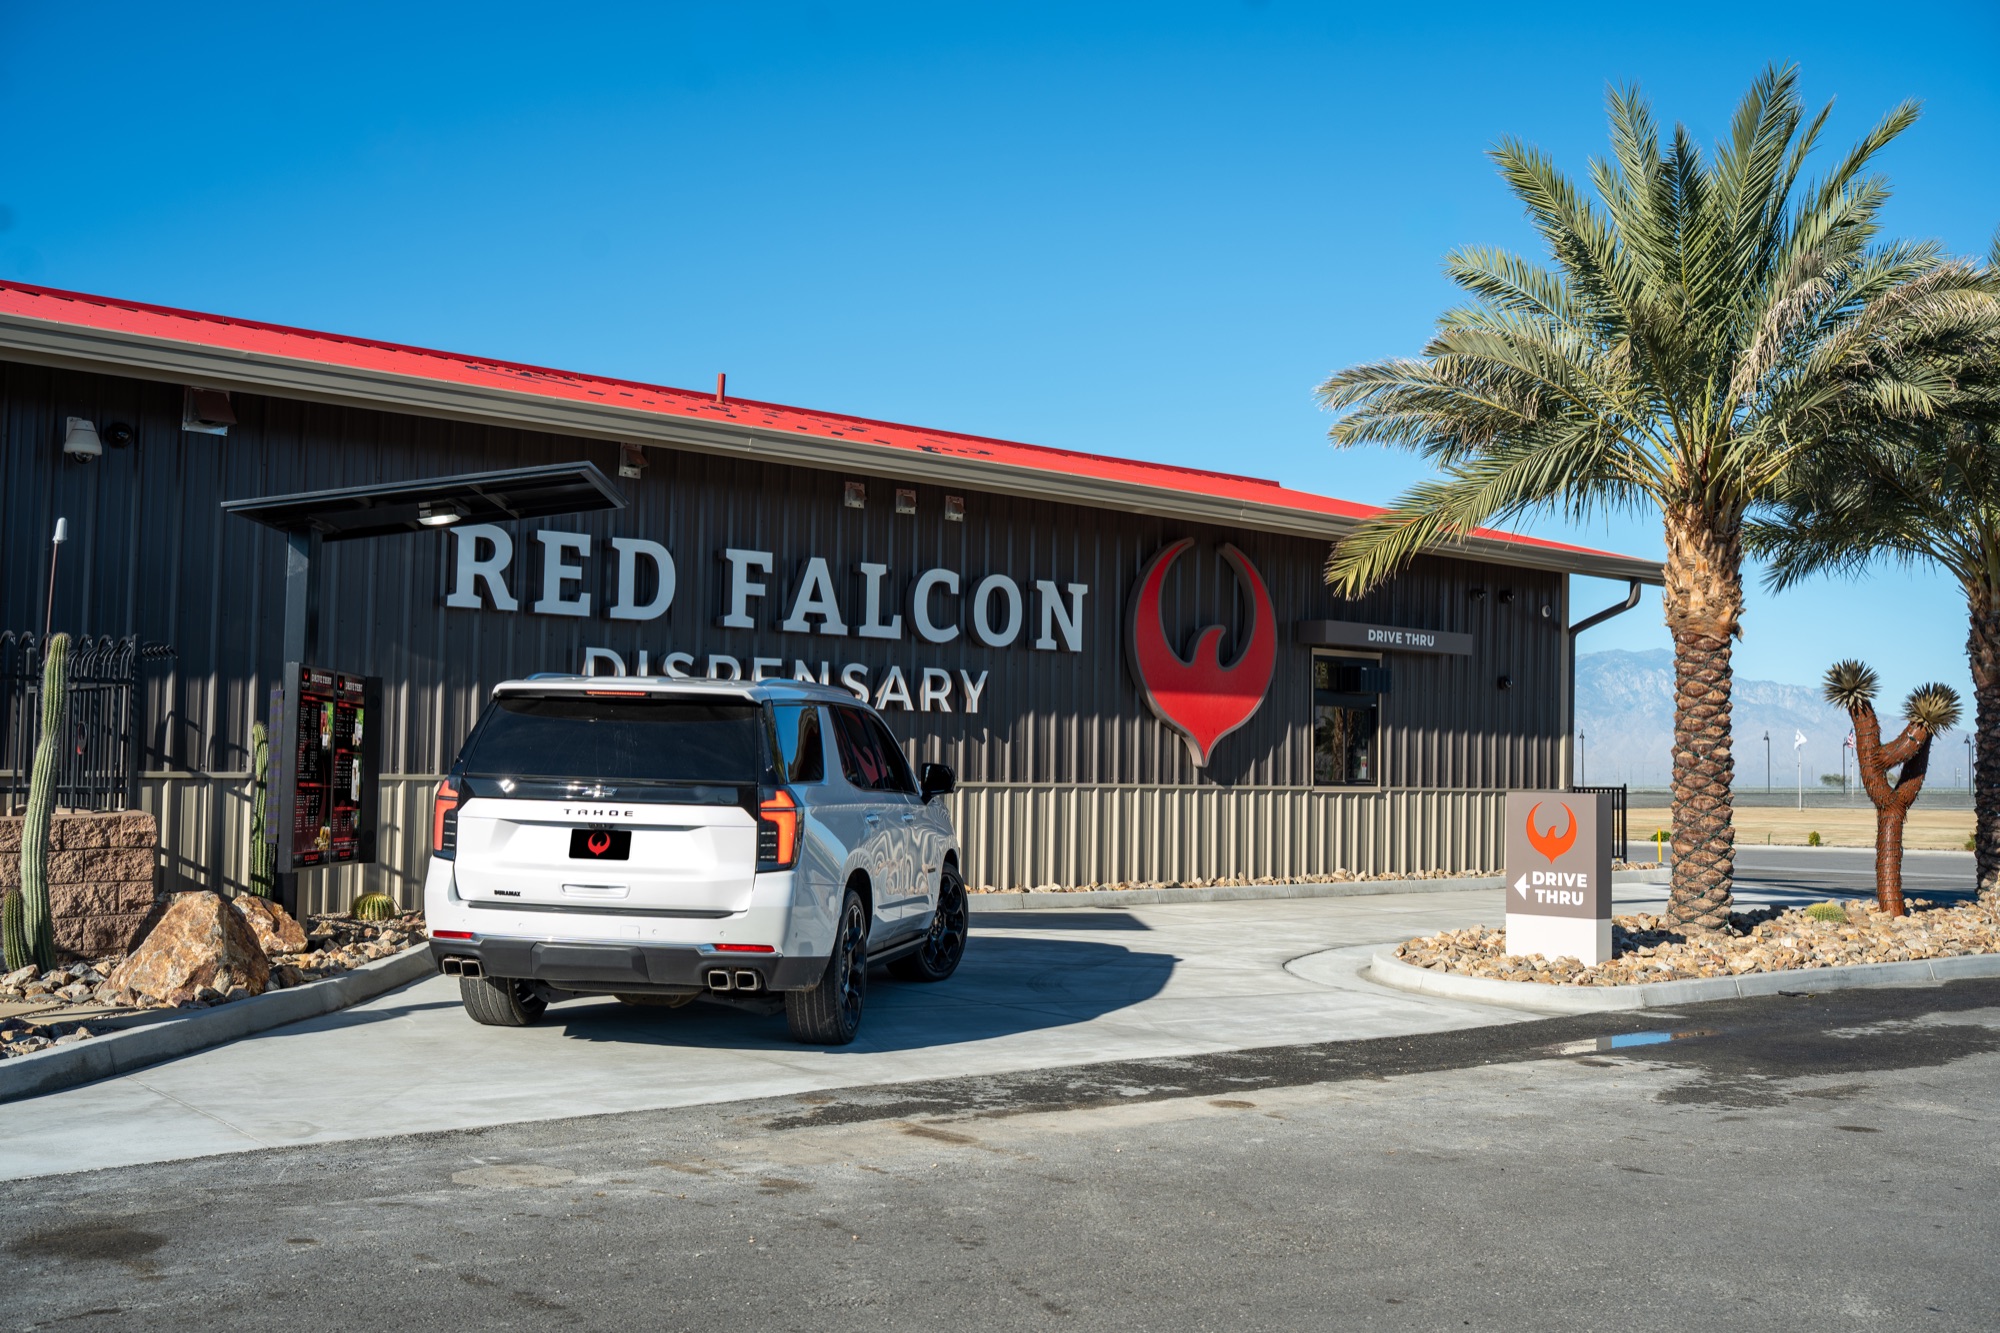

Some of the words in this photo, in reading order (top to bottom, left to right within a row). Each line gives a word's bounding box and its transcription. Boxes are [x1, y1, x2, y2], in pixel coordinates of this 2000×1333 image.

[447, 524, 677, 621] RED
[721, 548, 1089, 653] FALCON
[1368, 629, 1402, 644] DRIVE
[1405, 632, 1435, 647] THRU
[563, 808, 634, 817] TAHOE
[1532, 871, 1588, 888] DRIVE
[1534, 889, 1584, 906] THRU
